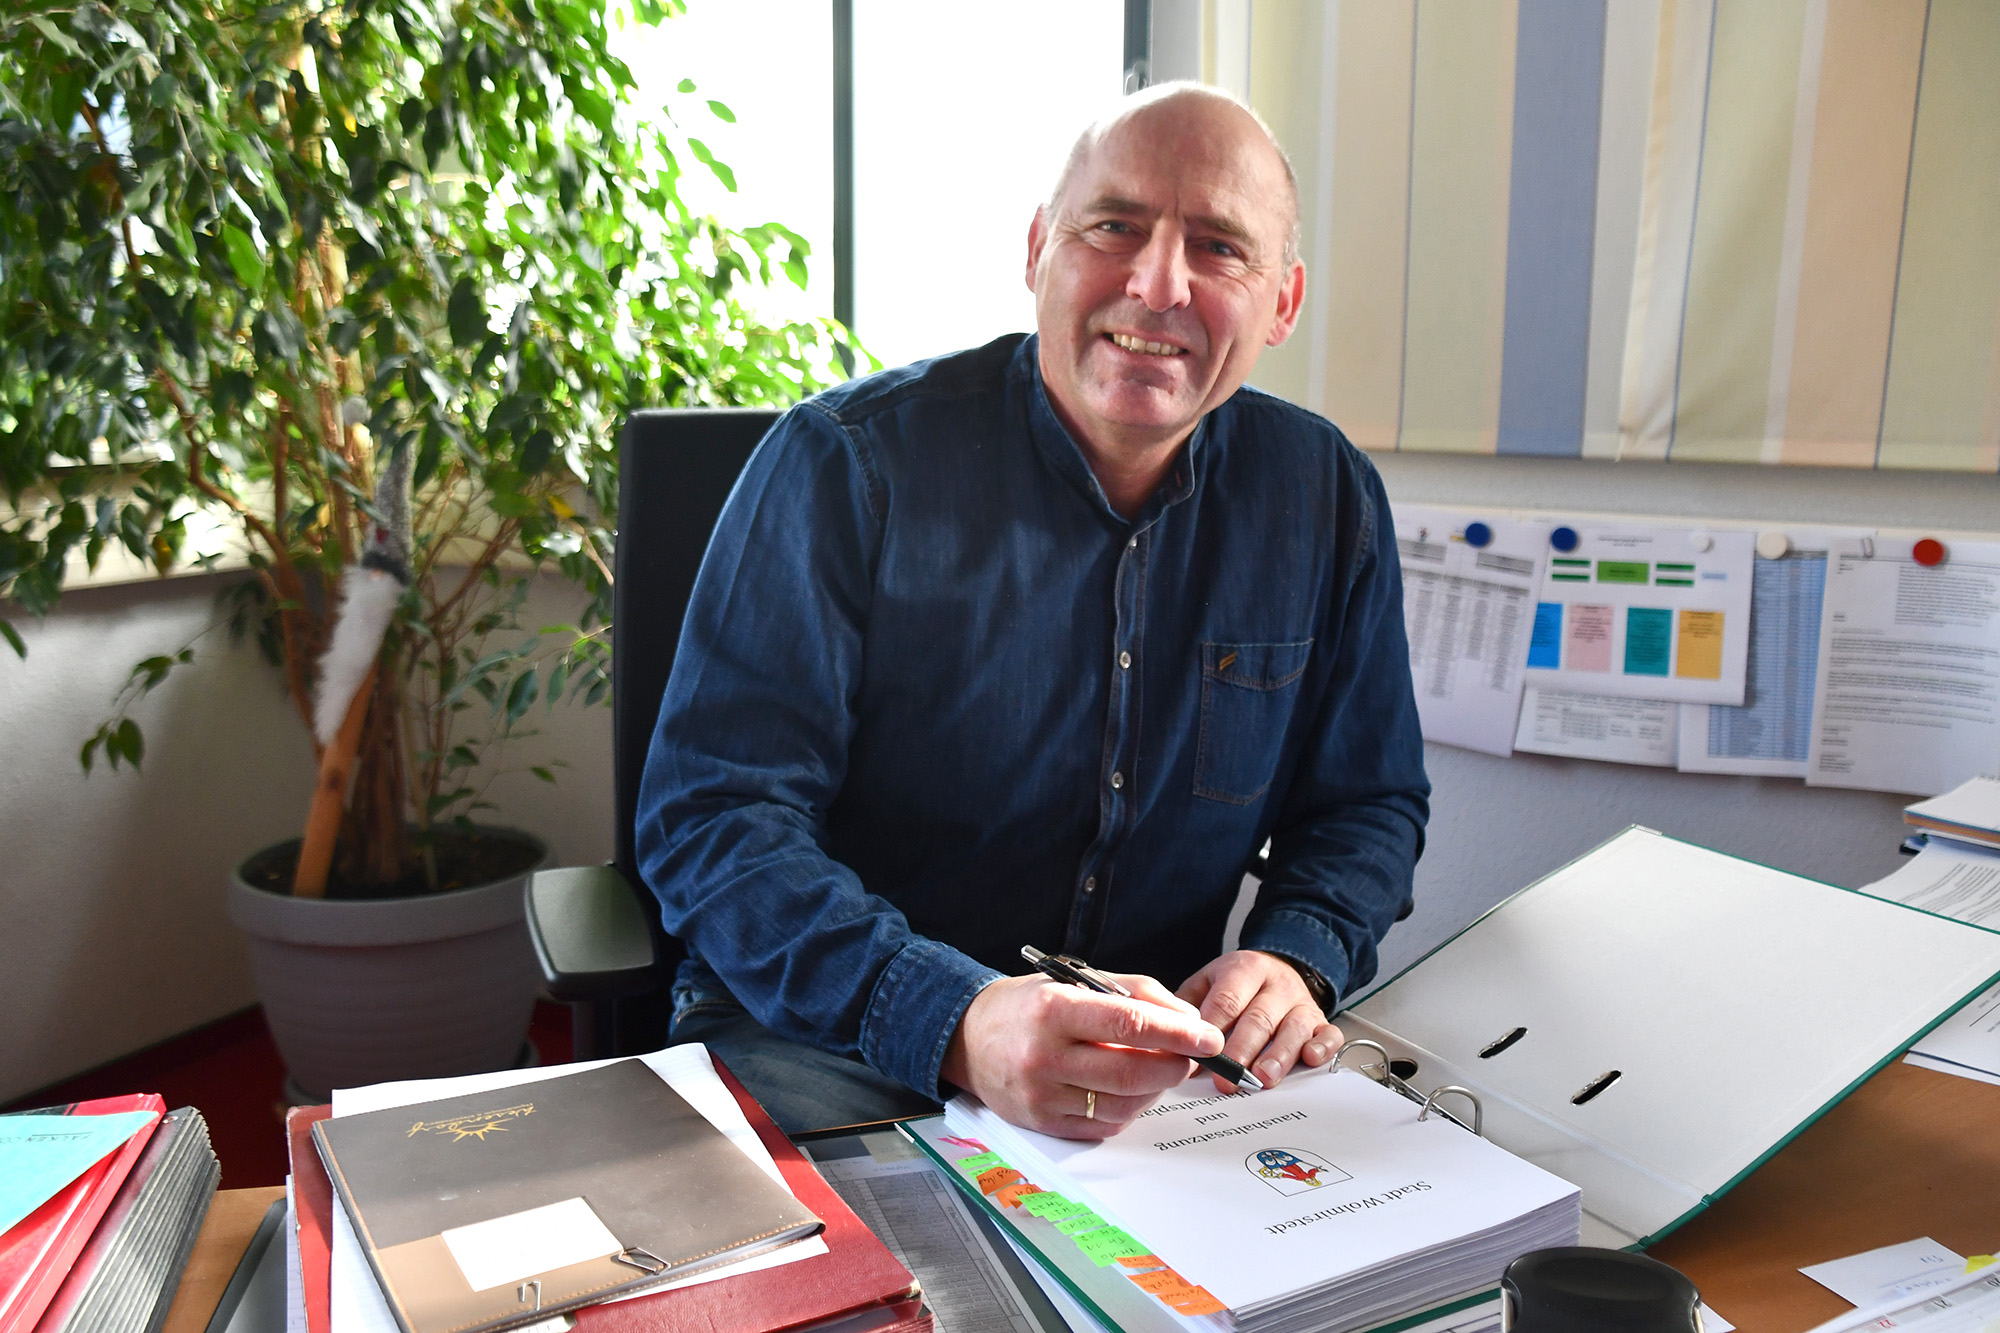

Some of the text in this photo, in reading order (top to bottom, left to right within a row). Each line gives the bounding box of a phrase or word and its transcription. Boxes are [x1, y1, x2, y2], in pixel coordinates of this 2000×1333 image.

[1154, 1110, 1308, 1152] Haushaltssatzung
[1194, 1111, 1229, 1126] und
[1264, 1181, 1432, 1235] Stadt Wolmirstedt
[1878, 1318, 1897, 1330] 22
